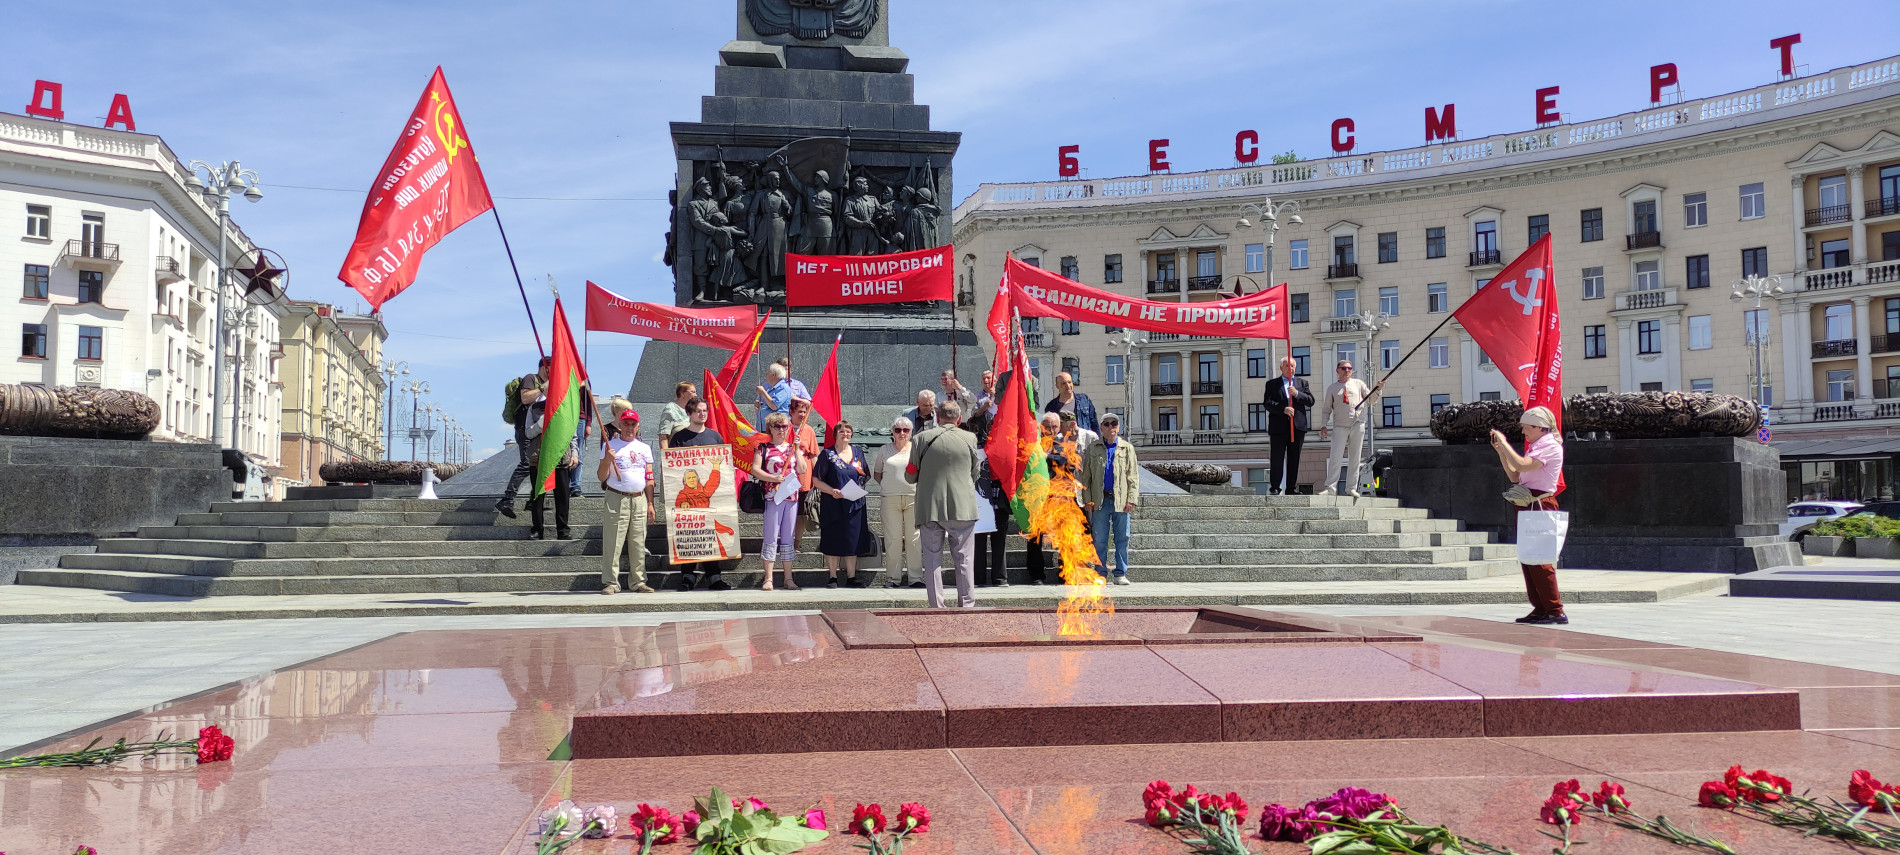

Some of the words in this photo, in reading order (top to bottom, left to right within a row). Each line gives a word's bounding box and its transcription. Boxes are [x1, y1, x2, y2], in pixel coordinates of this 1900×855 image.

[26, 79, 136, 131] ДА
[796, 261, 829, 274] НЕТ
[846, 263, 860, 276] III
[863, 252, 944, 276] МИРОВОЙ
[841, 280, 903, 297] ВОЙНЕ!
[1023, 284, 1131, 317] ФАШИЗМ
[1139, 305, 1167, 322] НЕ
[1176, 302, 1276, 326] ПРОЙДЕТ!
[630, 315, 661, 329] блок
[665, 447, 729, 460] РОДИНА-МАТЬ
[667, 457, 705, 468] ЗОВЕТ
